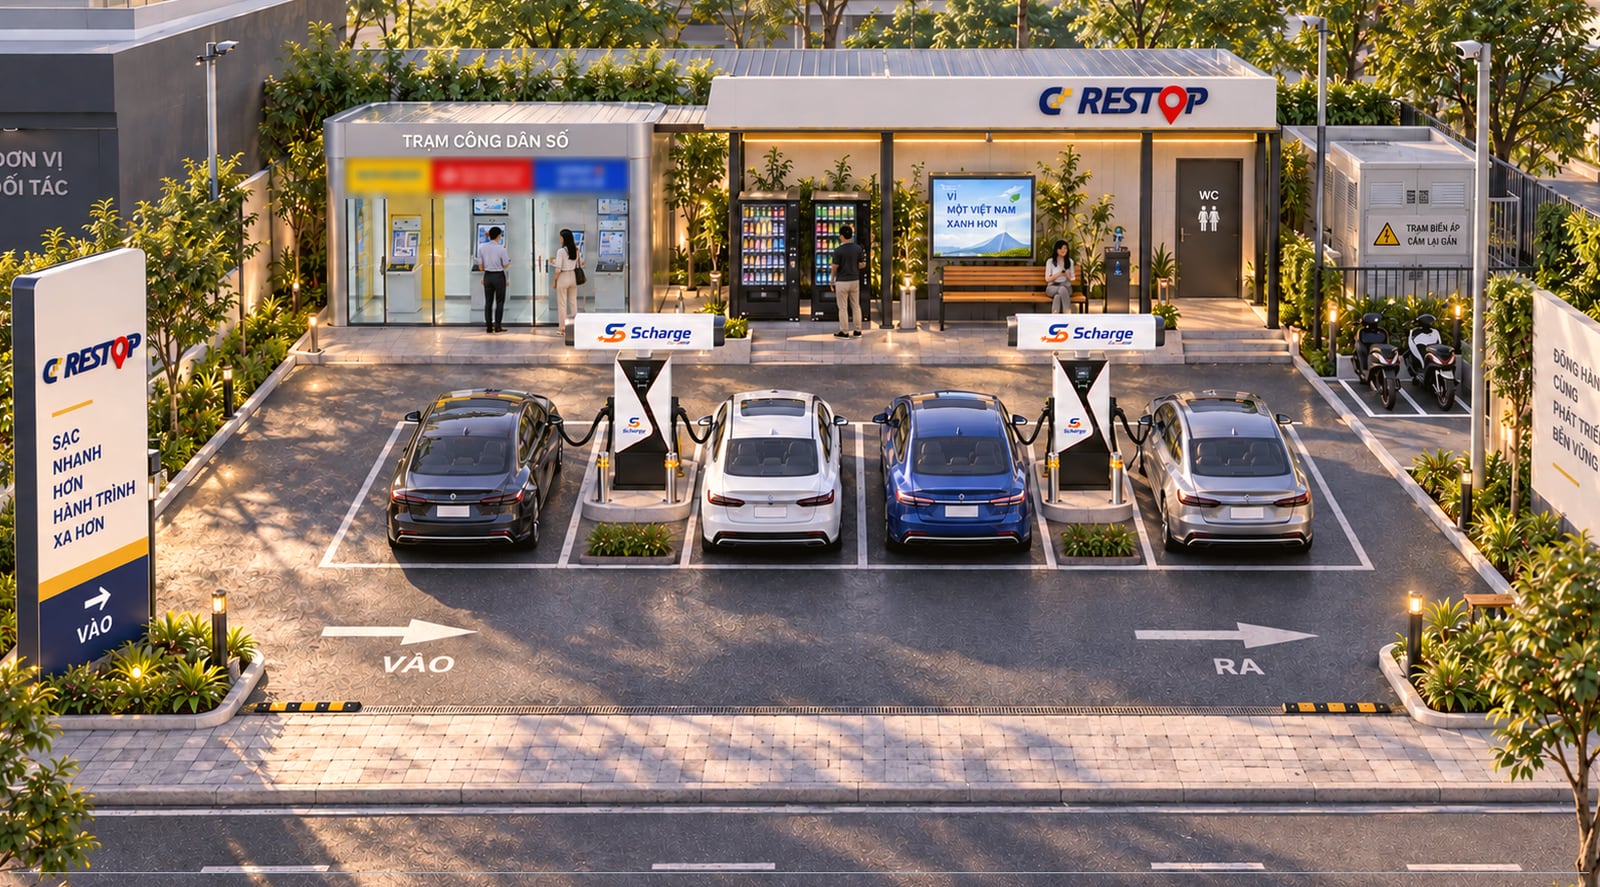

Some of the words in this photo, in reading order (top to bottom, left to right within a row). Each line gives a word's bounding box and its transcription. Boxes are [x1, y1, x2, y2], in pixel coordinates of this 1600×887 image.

[402, 134, 449, 152] TRẠM
[453, 130, 502, 149] CÔNG
[506, 131, 542, 149] DÂN
[545, 129, 569, 149] SỐ
[42, 151, 63, 172] VỊ
[0, 173, 24, 196] ỐI
[29, 175, 68, 196] TÁC
[1199, 190, 1219, 201] WC
[994, 205, 1017, 215] NAM
[946, 219, 975, 229] XANH
[630, 325, 692, 342] Scharge
[1072, 326, 1134, 343] Scharge
[52, 428, 80, 450] SẠC
[53, 444, 102, 475] NHANH
[53, 475, 83, 500] HƠN
[53, 496, 92, 525] HÀNH
[95, 479, 135, 508] TRÌNH
[53, 529, 73, 549] XA
[75, 515, 104, 541] HƠN
[76, 614, 113, 644] VÀO
[1213, 658, 1266, 675] RA
